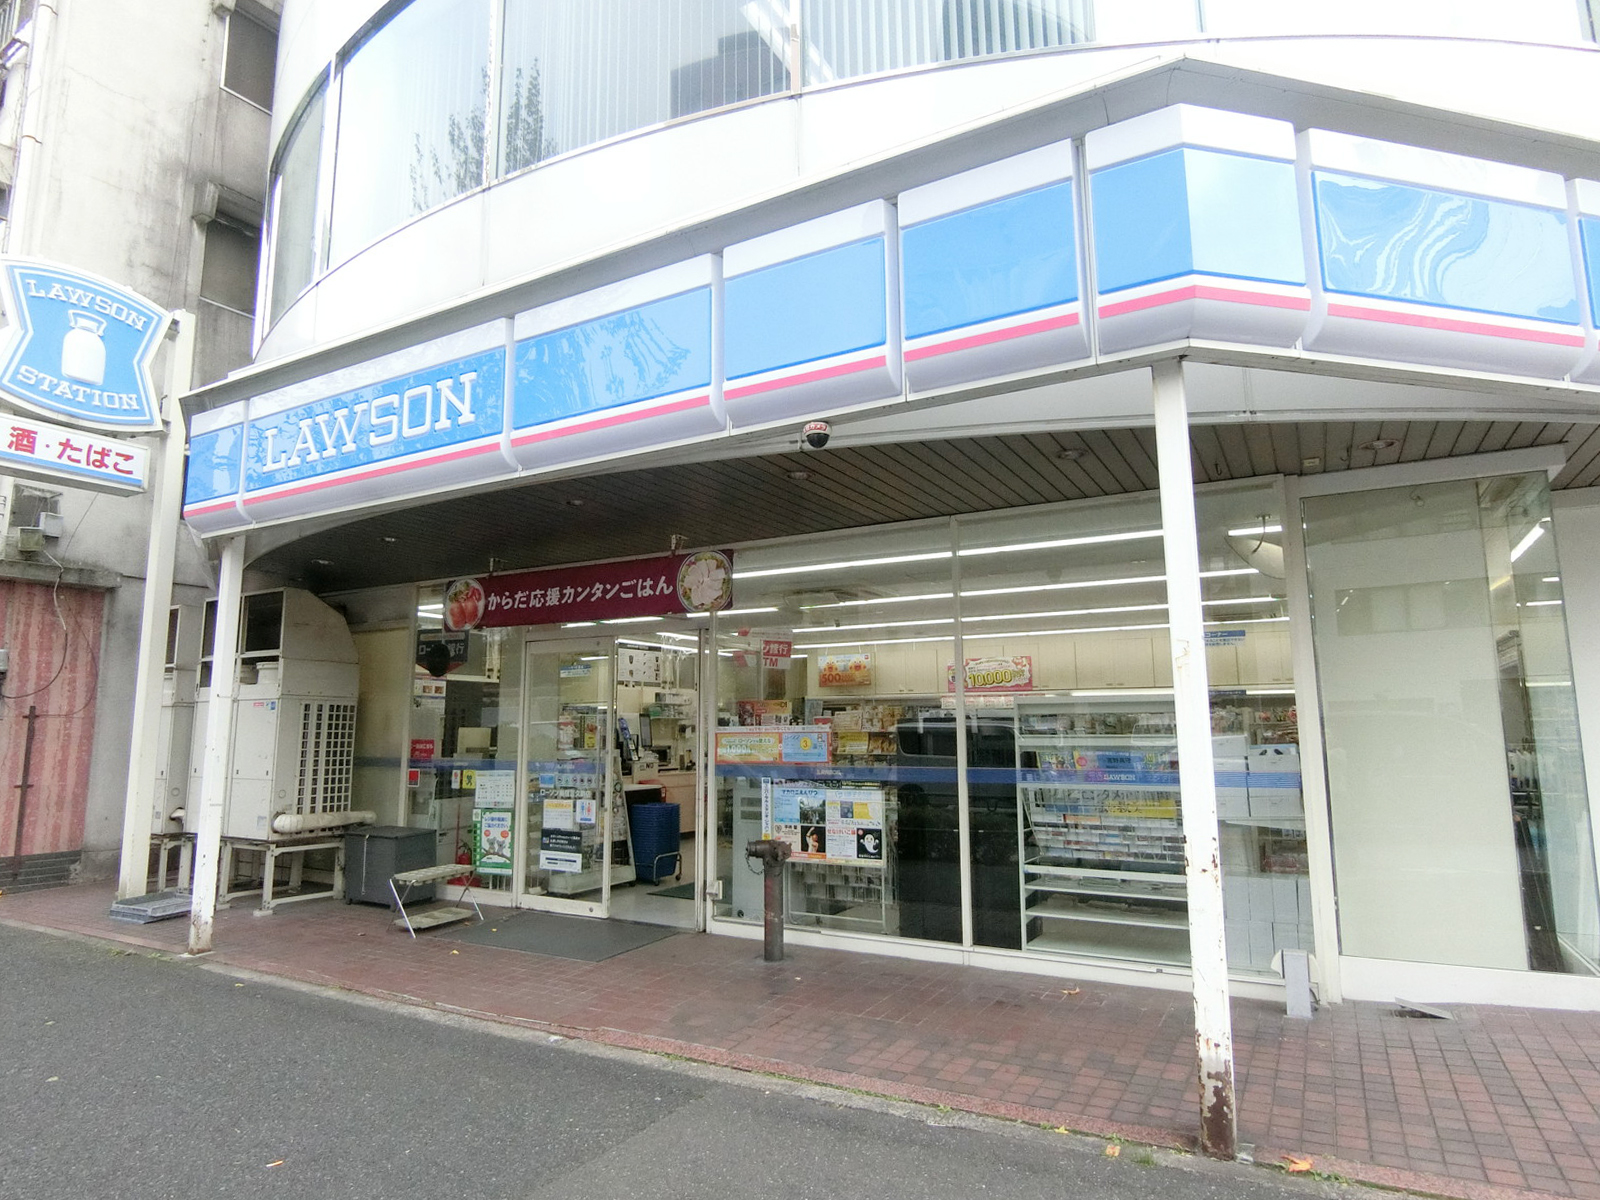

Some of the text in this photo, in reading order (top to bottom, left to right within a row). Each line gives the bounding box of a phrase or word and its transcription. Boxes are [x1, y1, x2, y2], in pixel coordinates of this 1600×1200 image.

[25, 278, 148, 332] LAWSON
[16, 364, 140, 411] STATION
[262, 370, 478, 474] LAWSON
[7, 425, 135, 476] 酒・たばこ
[487, 575, 674, 611] からだ応援カンタンごはん
[821, 673, 841, 683] 500
